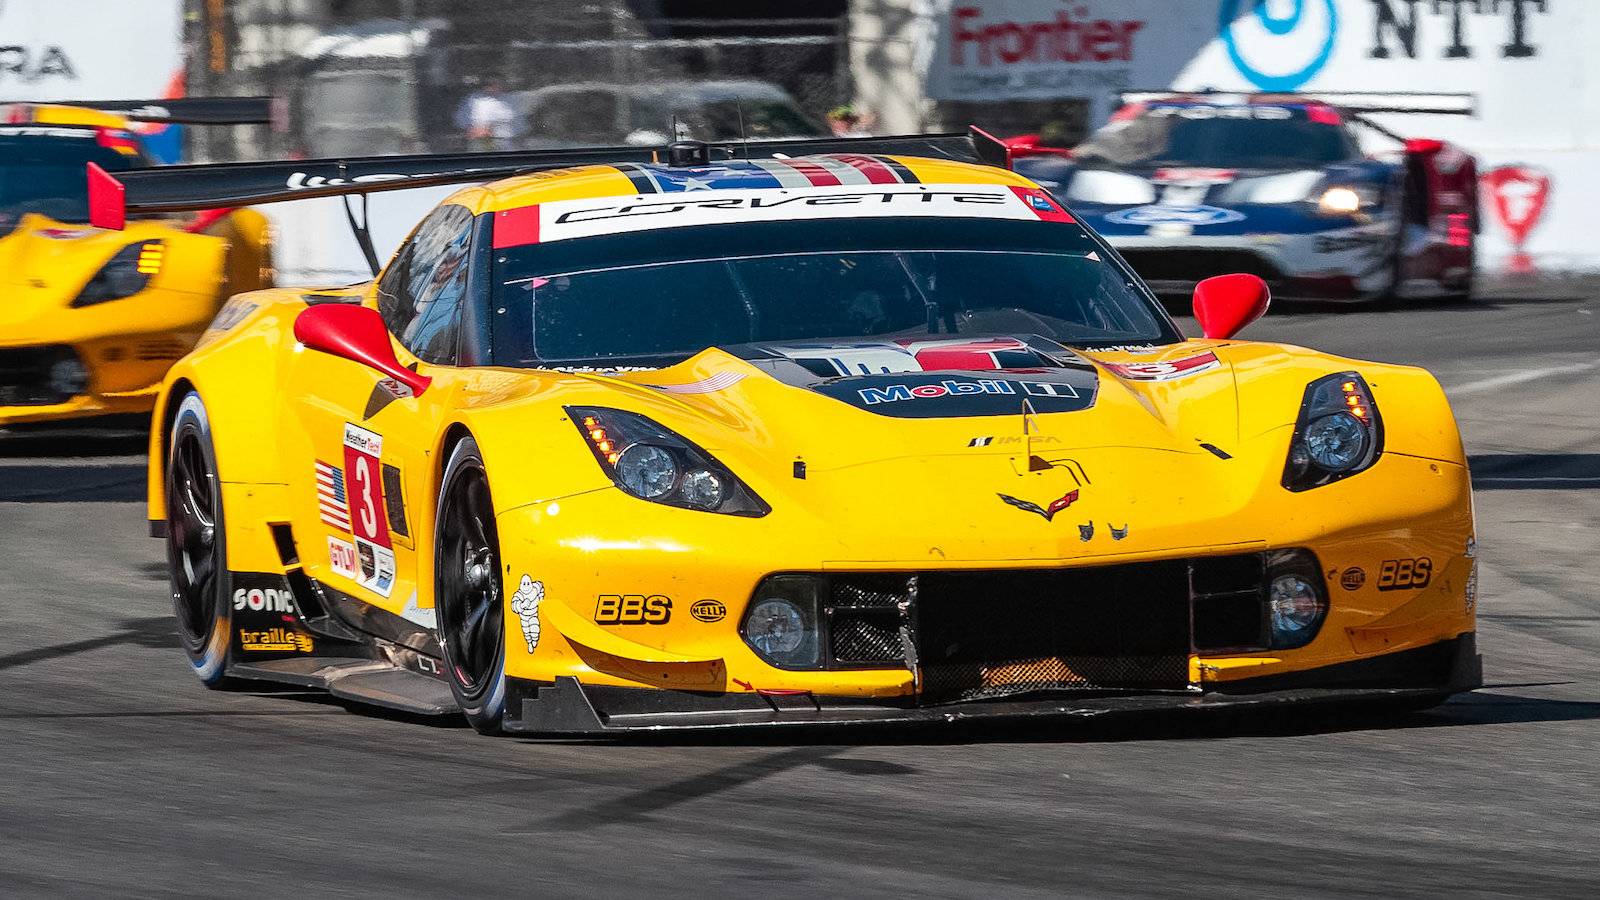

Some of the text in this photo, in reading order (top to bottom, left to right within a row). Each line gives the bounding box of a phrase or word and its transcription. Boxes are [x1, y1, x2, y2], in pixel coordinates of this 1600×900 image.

[950, 6, 1146, 66] Frontier
[1367, 0, 1549, 58] NTT
[555, 192, 1005, 224] CORVETTE
[857, 380, 1016, 404] Mobil
[356, 456, 377, 538] 3
[1378, 557, 1433, 591] BBS
[594, 594, 672, 625] BBS
[692, 605, 727, 616] HELLA
[240, 628, 296, 644] braille
